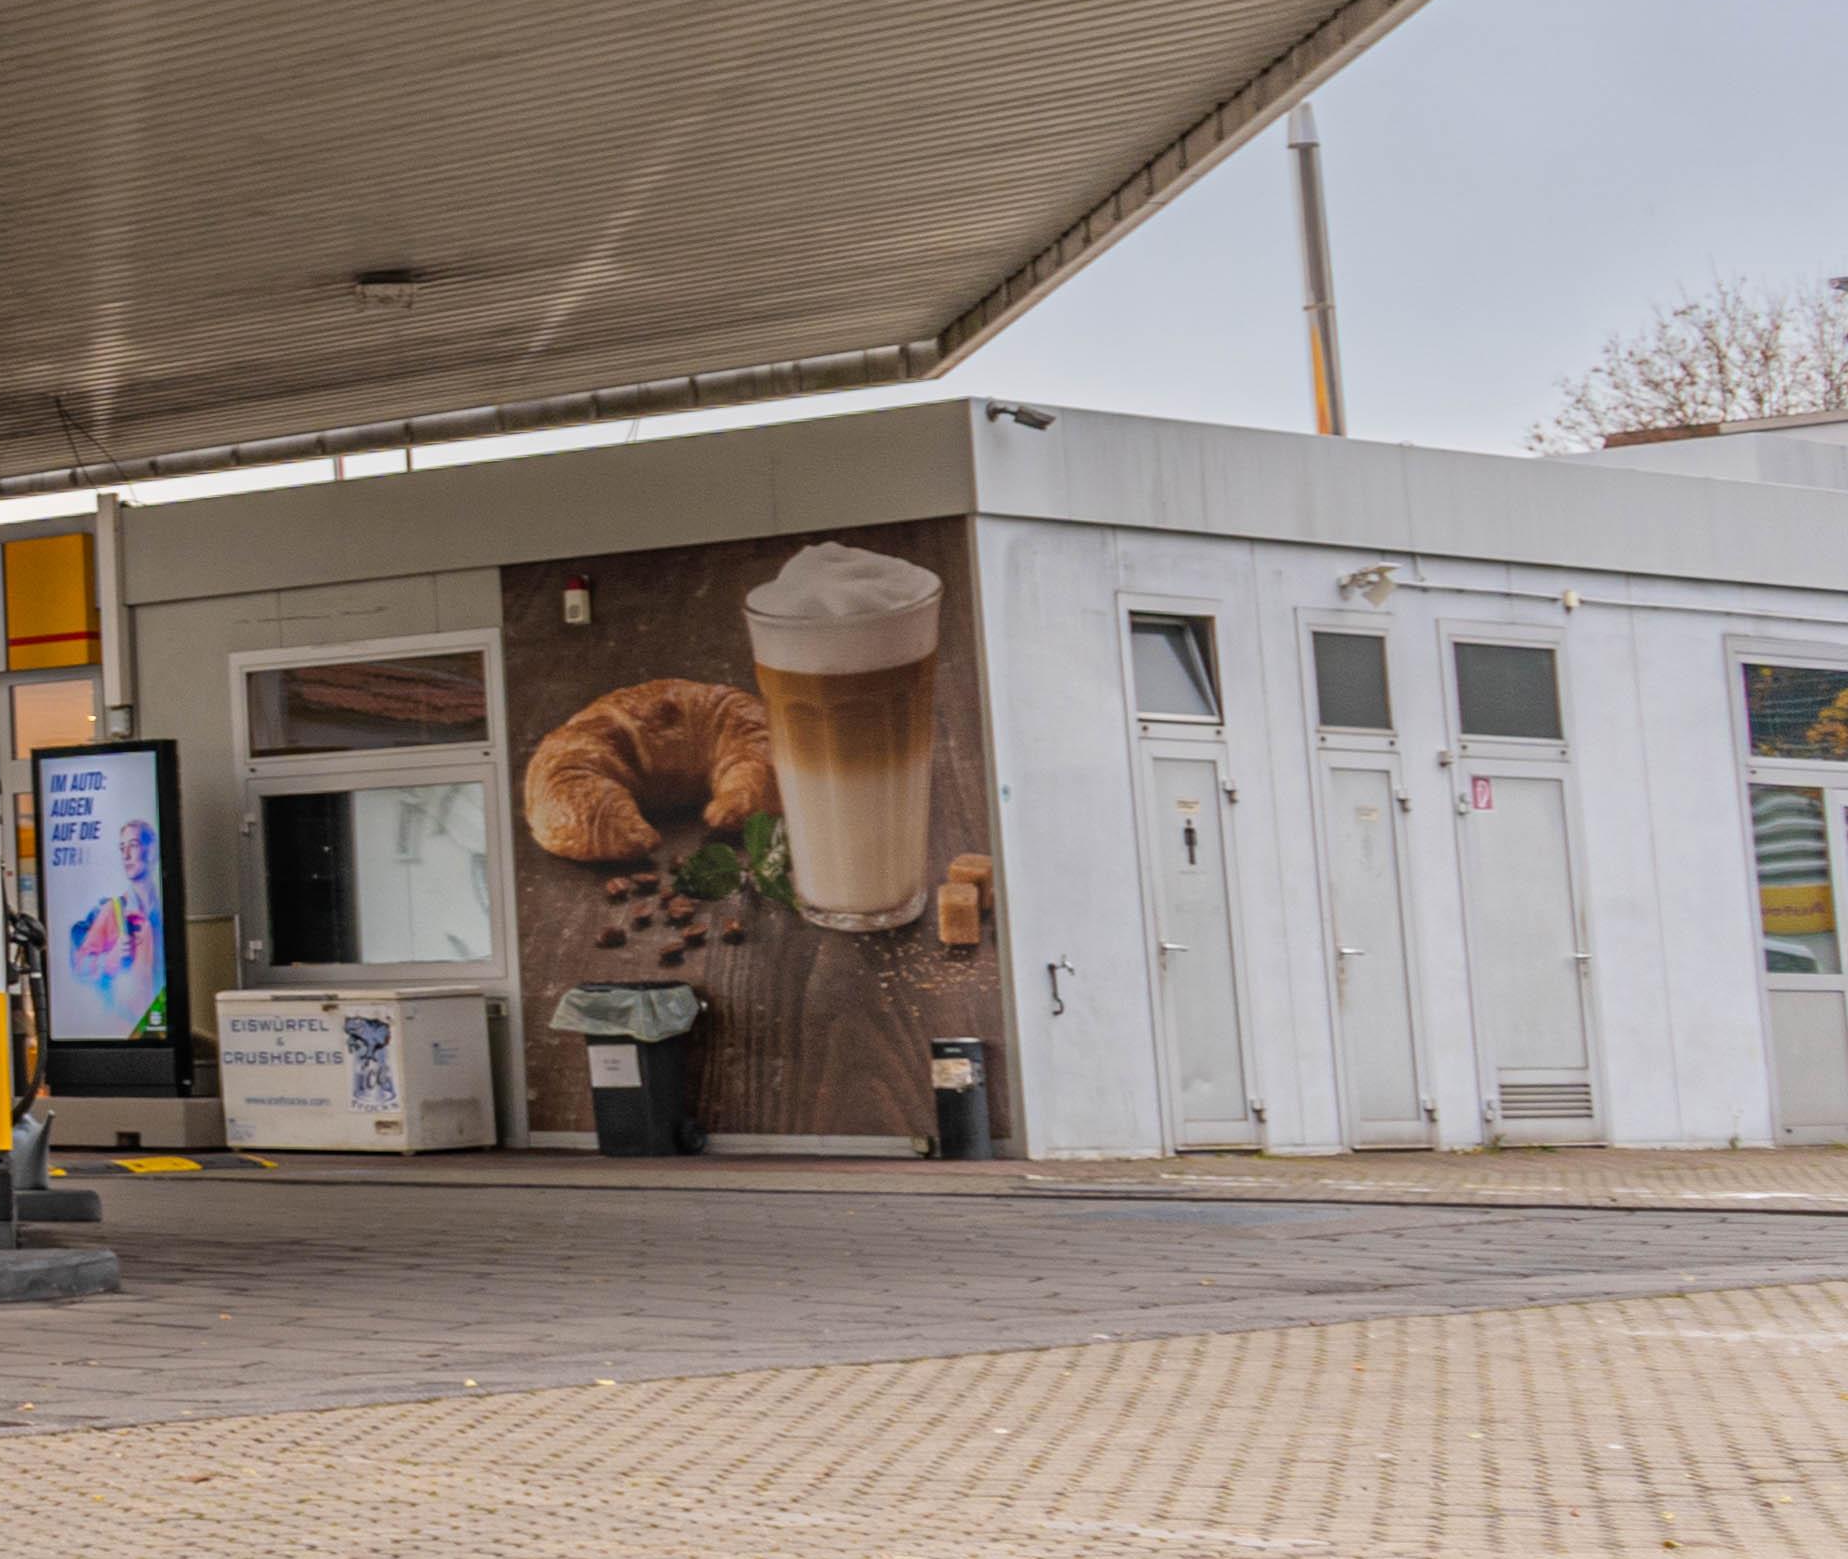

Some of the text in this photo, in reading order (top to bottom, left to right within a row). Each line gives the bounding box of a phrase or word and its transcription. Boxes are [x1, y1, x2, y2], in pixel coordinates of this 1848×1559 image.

[50, 774, 67, 793] IM
[50, 797, 94, 818] AUGEN
[52, 821, 102, 842] AUF DIE
[230, 1015, 330, 1032] EISWÜRFEL
[222, 1051, 345, 1065] CRUSHED-EIS
